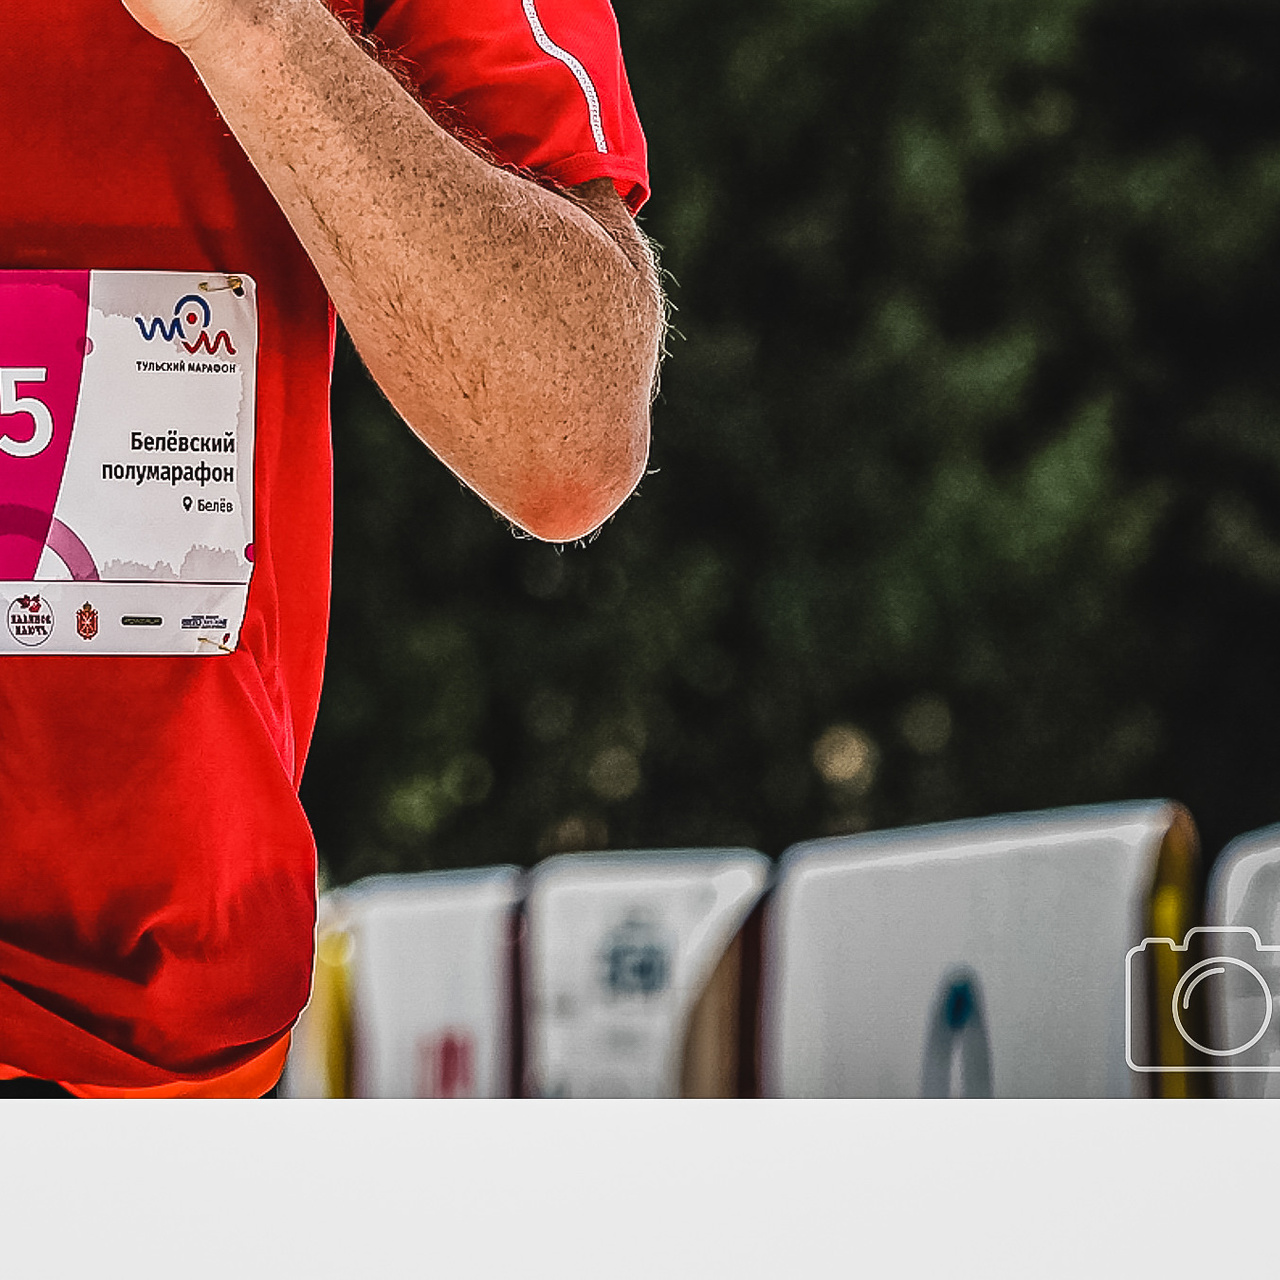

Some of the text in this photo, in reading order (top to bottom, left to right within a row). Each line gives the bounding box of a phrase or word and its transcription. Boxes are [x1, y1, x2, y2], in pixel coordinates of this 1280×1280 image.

[135, 360, 237, 374] ТУЛЬСКИЙ МАРАФОН
[130, 429, 236, 454] Белёвский
[101, 460, 235, 487] полумарафон
[197, 498, 234, 513] Белёв
